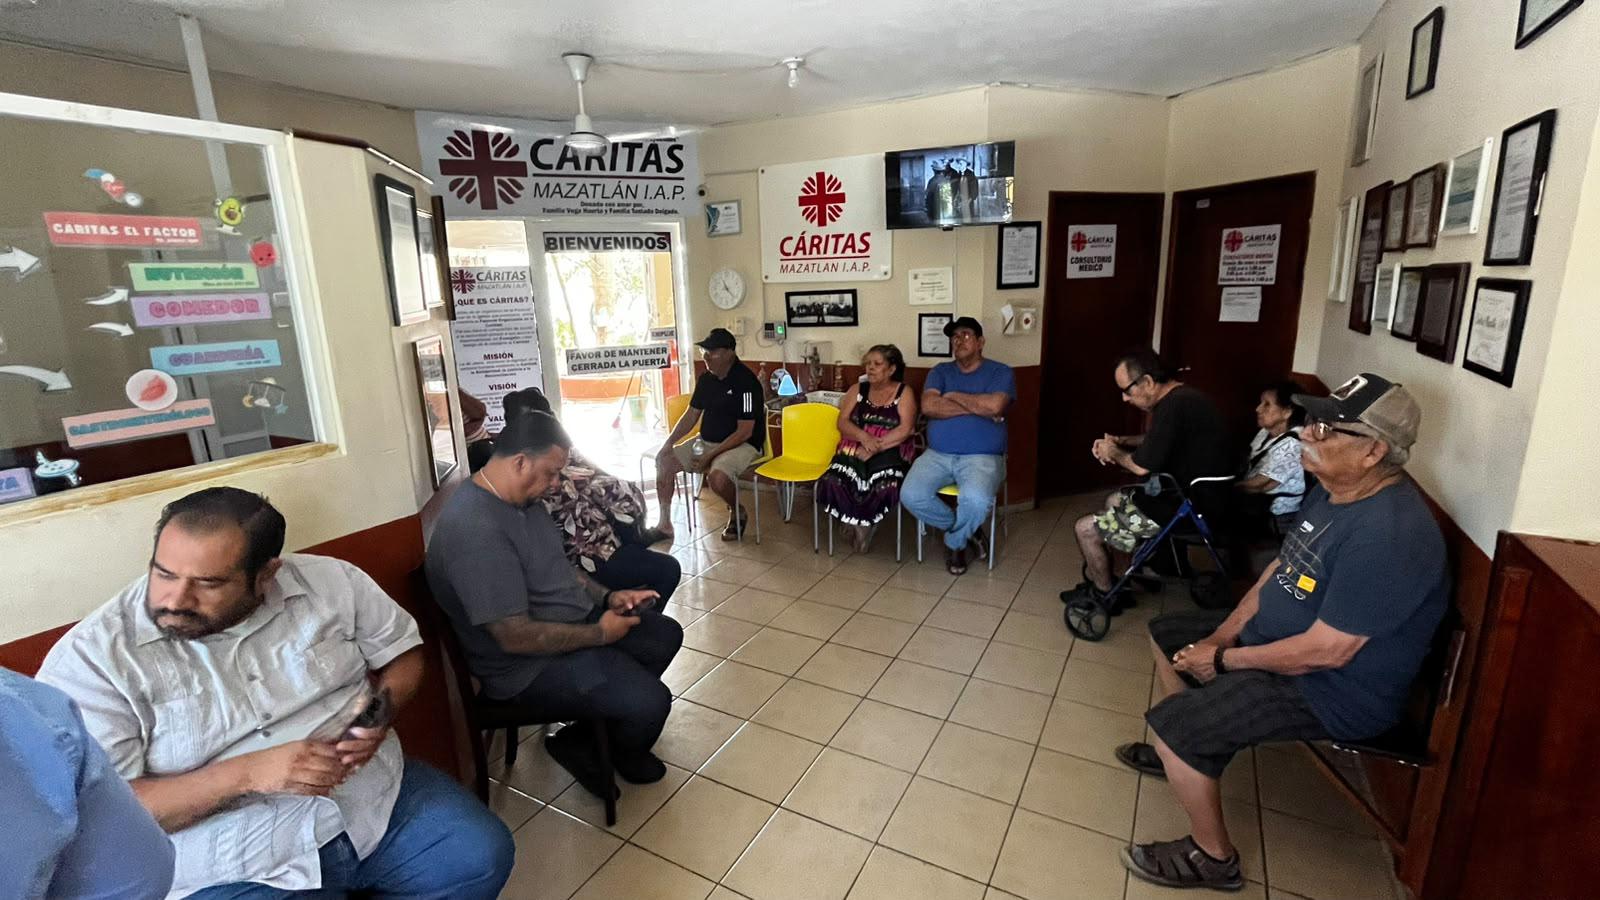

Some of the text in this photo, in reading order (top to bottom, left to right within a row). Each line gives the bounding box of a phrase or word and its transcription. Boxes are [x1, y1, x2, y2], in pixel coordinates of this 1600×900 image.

[533, 180, 685, 200] MAZATLÁN I.A.P.
[124, 226, 140, 237] EL
[143, 226, 197, 238] FACTOR
[546, 236, 668, 251] BIENVENIDOS
[779, 230, 871, 257] CÁRITAS
[476, 270, 526, 282] CÁRITAS
[148, 298, 260, 318] COMEDOR
[483, 352, 513, 361] MISIÓN
[570, 347, 667, 360] FAVOR DE MANTENER
[571, 361, 616, 372] CERRADA
[632, 357, 667, 367] PUERTA
[488, 382, 517, 391] VISIÓN
